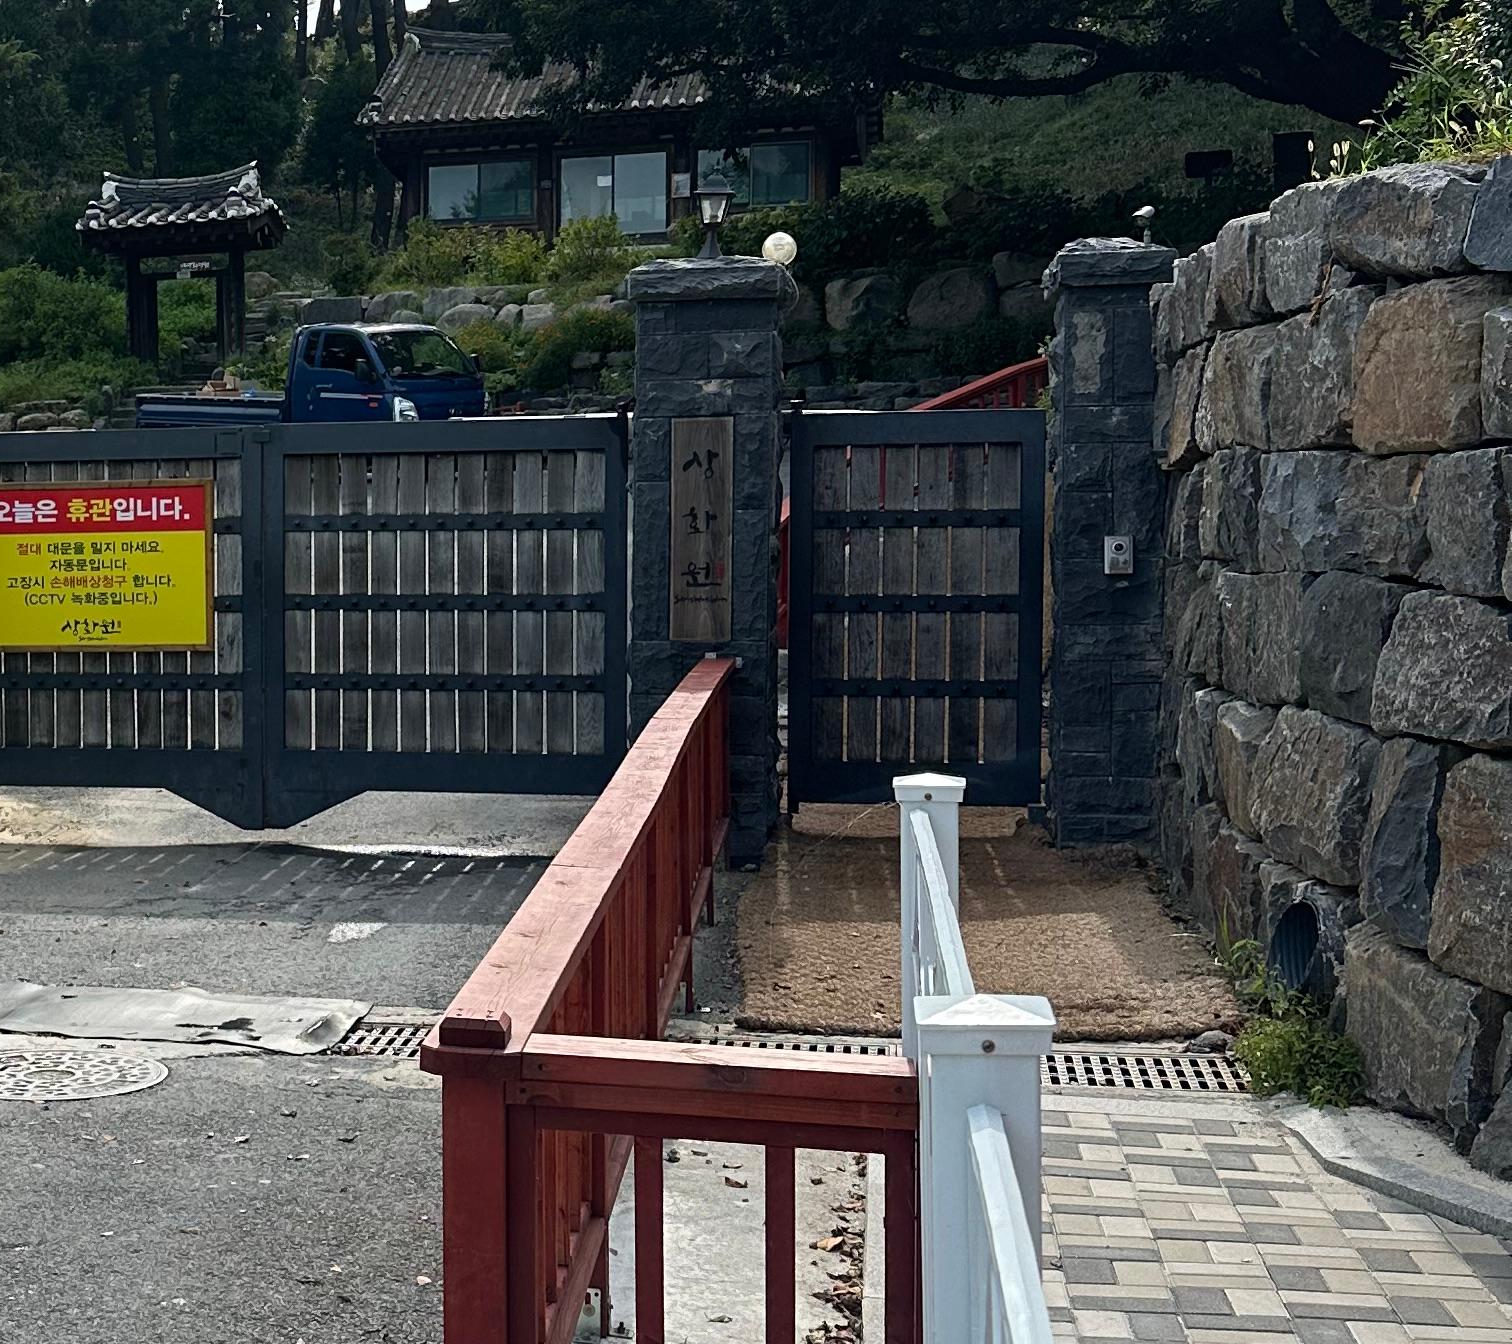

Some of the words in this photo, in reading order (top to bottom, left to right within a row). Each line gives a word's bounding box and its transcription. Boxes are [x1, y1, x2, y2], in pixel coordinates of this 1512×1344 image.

[66, 496, 190, 523] 휴관입니다.
[16, 542, 42, 556] 절대
[47, 541, 85, 555] 대문을
[90, 541, 116, 555] 밀지
[121, 540, 164, 554] 마세요.
[6, 576, 45, 589] 고장시
[50, 575, 127, 589] 손해배상청구
[132, 574, 176, 588] 합니다.
[24, 593, 66, 606] (CCTV
